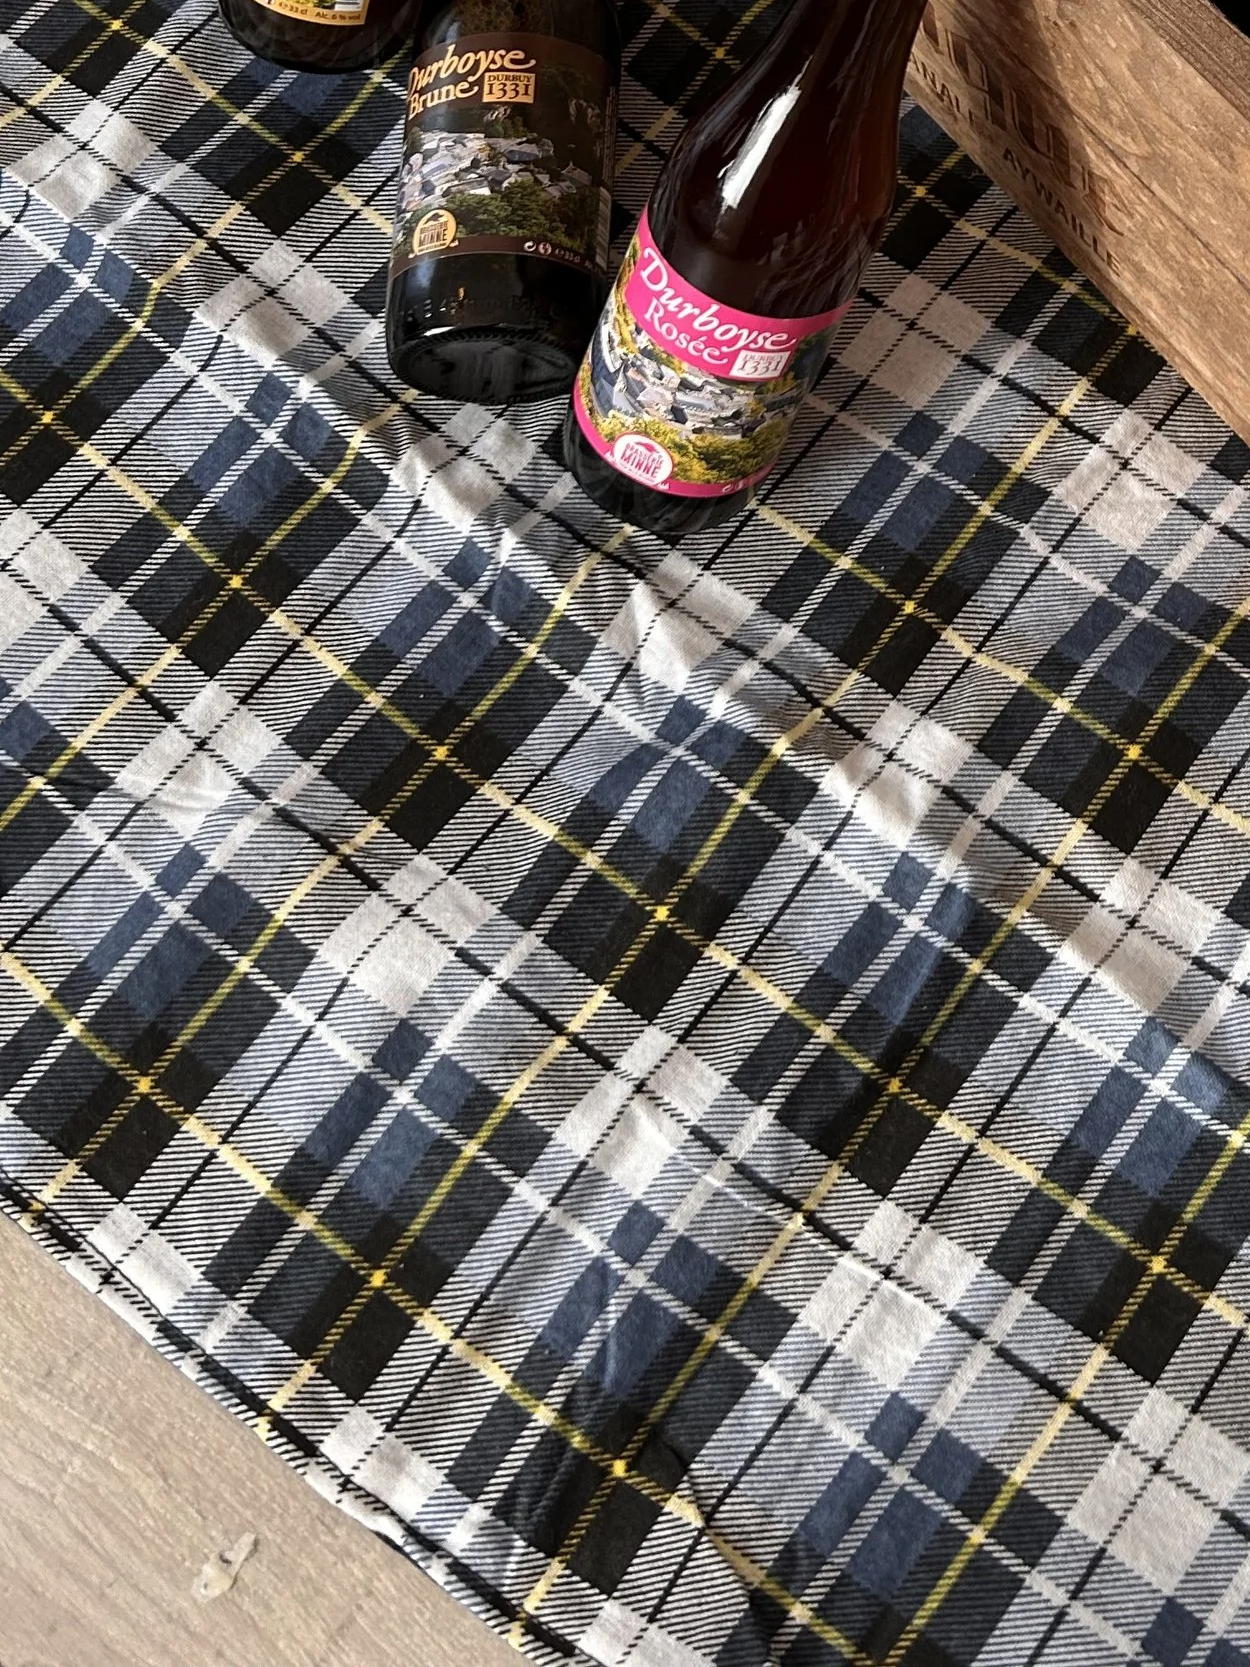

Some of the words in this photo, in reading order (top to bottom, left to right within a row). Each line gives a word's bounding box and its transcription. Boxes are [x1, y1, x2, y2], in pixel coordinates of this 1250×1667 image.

[485, 83, 533, 101] 1331
[486, 73, 534, 85] DURBUY
[1002, 147, 1121, 277] AYWAILLE
[640, 246, 797, 352] Durboyse
[644, 299, 731, 365] Rosée
[738, 360, 783, 378] 1331
[619, 449, 661, 479] MINNE
